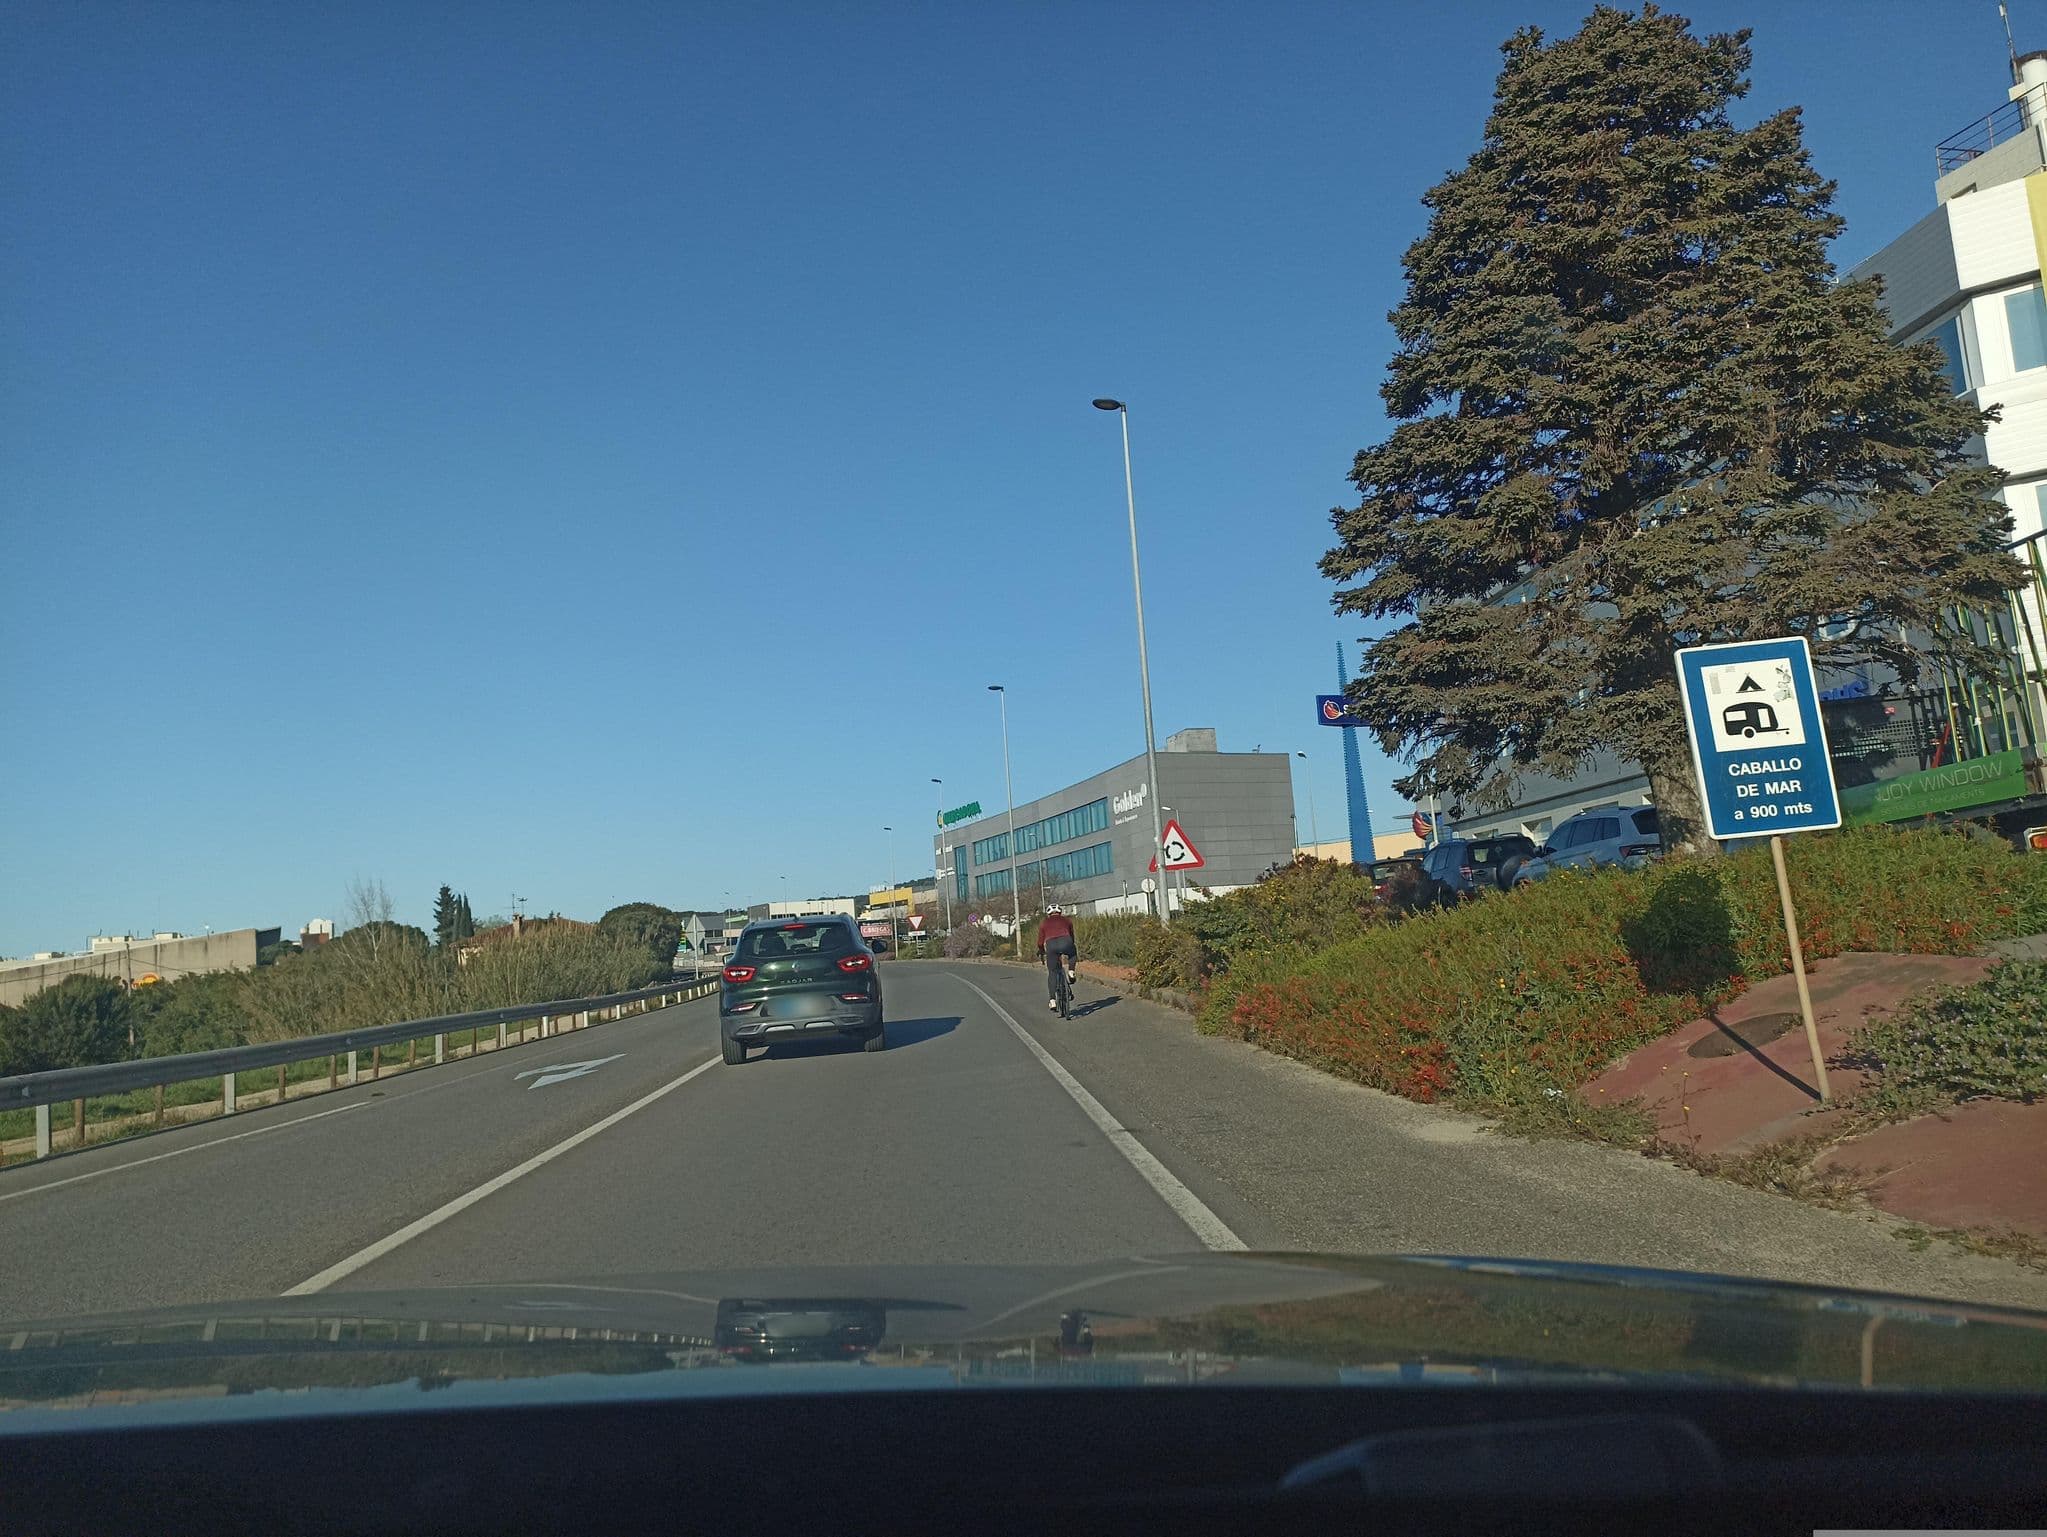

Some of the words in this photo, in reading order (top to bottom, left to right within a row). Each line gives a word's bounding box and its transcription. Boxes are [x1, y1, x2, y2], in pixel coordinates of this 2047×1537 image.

[1728, 757, 1802, 777] CABALLO
[1919, 760, 2002, 793] WINDOW
[1736, 783, 1760, 798] DE
[1764, 780, 1802, 795] MAR
[1734, 809, 1744, 820] a
[1750, 804, 1778, 818] 900
[1784, 801, 1813, 815] mts
